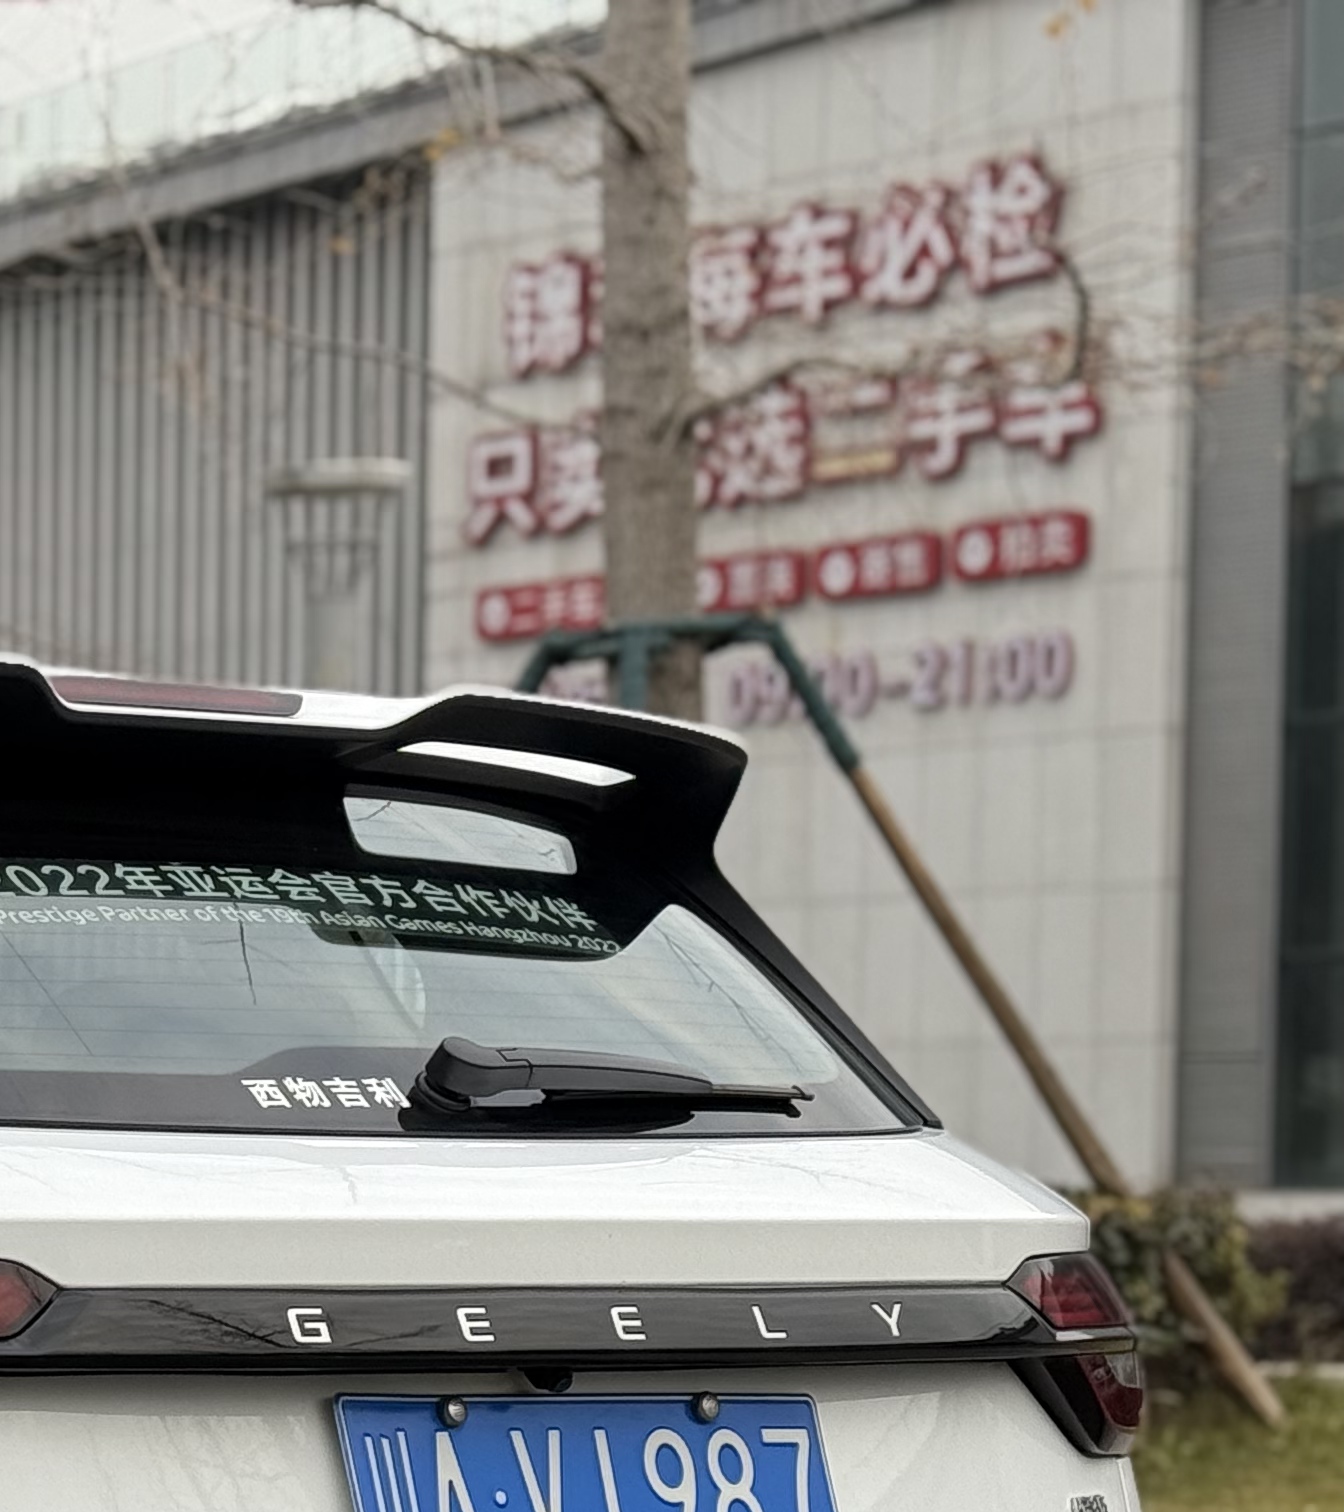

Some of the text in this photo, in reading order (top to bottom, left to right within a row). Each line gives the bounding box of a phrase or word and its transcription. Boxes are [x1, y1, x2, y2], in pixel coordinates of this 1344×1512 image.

[464, 332, 1105, 547] 只卖选二手车
[97, 906, 191, 922] Partner
[193, 905, 221, 922] of
[220, 906, 265, 923] the
[263, 908, 321, 925] 19th
[319, 910, 387, 929] Asian
[384, 914, 464, 935] Games
[459, 920, 572, 947] Hangzhou
[240, 1076, 412, 1109] 西物吉利
[286, 1302, 902, 1345] GEELY
